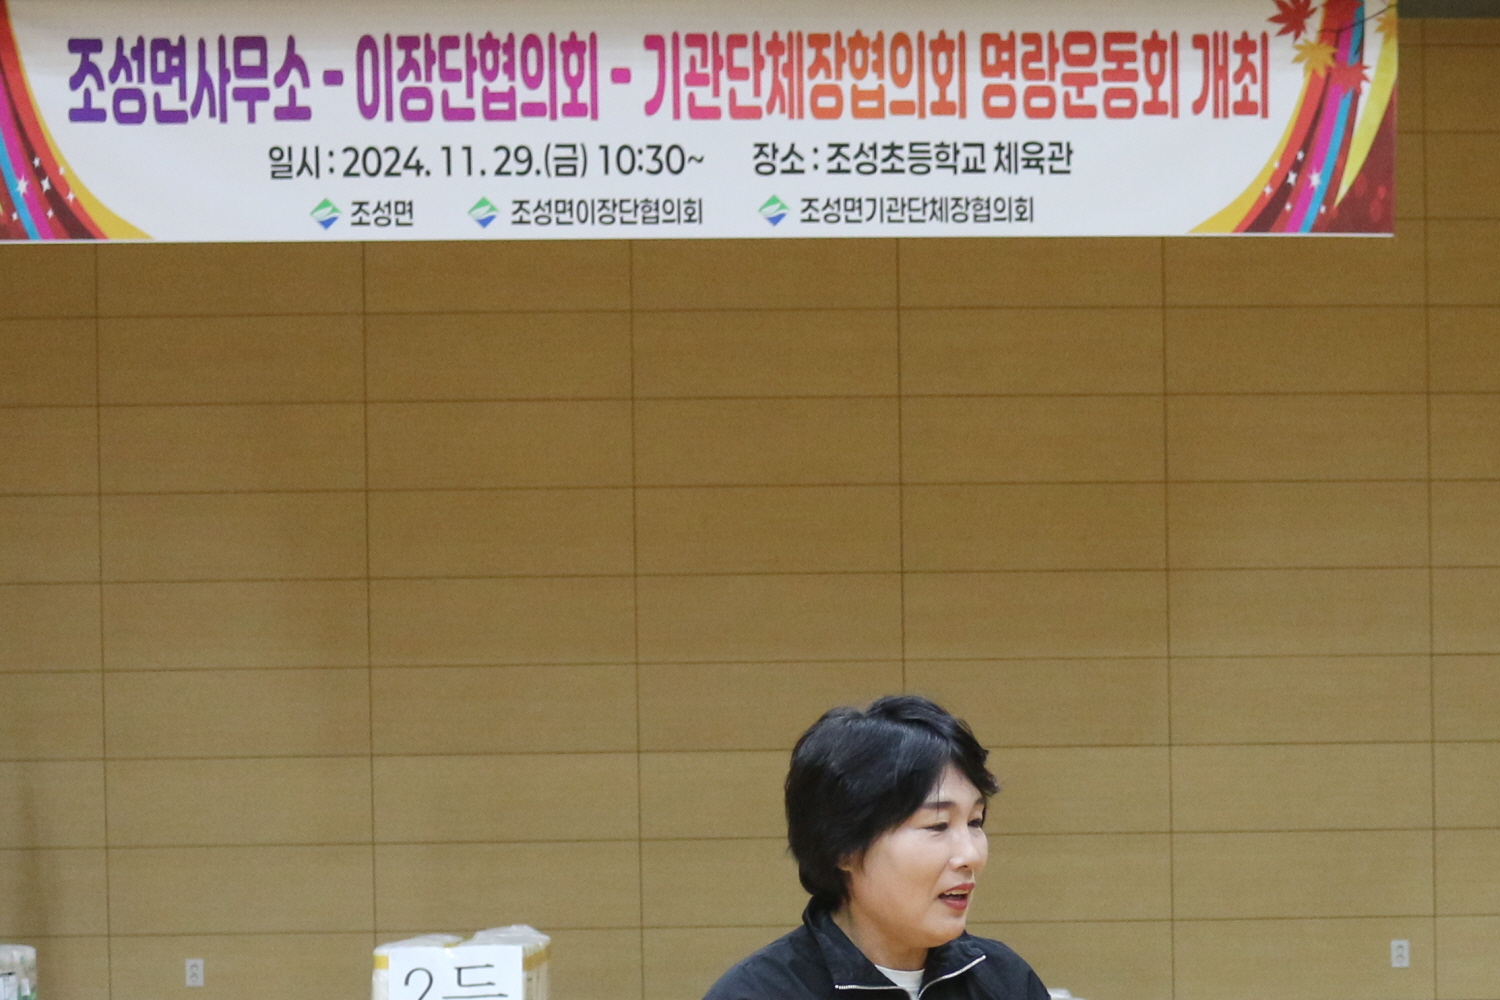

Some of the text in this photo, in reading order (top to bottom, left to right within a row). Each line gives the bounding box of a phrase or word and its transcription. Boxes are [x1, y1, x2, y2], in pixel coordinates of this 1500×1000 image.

[68, 35, 312, 125] 조성면사무소
[356, 31, 599, 122] 이장단협의회
[643, 29, 967, 120] 기관단체장협의회
[979, 29, 1179, 119] 명랑운동회
[1191, 30, 1269, 119] 개최
[599, 144, 704, 176] 10:30~
[826, 141, 987, 176] 조성초등학교
[994, 141, 1074, 175] 체육관
[351, 200, 413, 228] 조성면
[511, 198, 703, 226] 조성면이장단협의회
[800, 196, 1034, 224] 조성면기관단체장협의회
